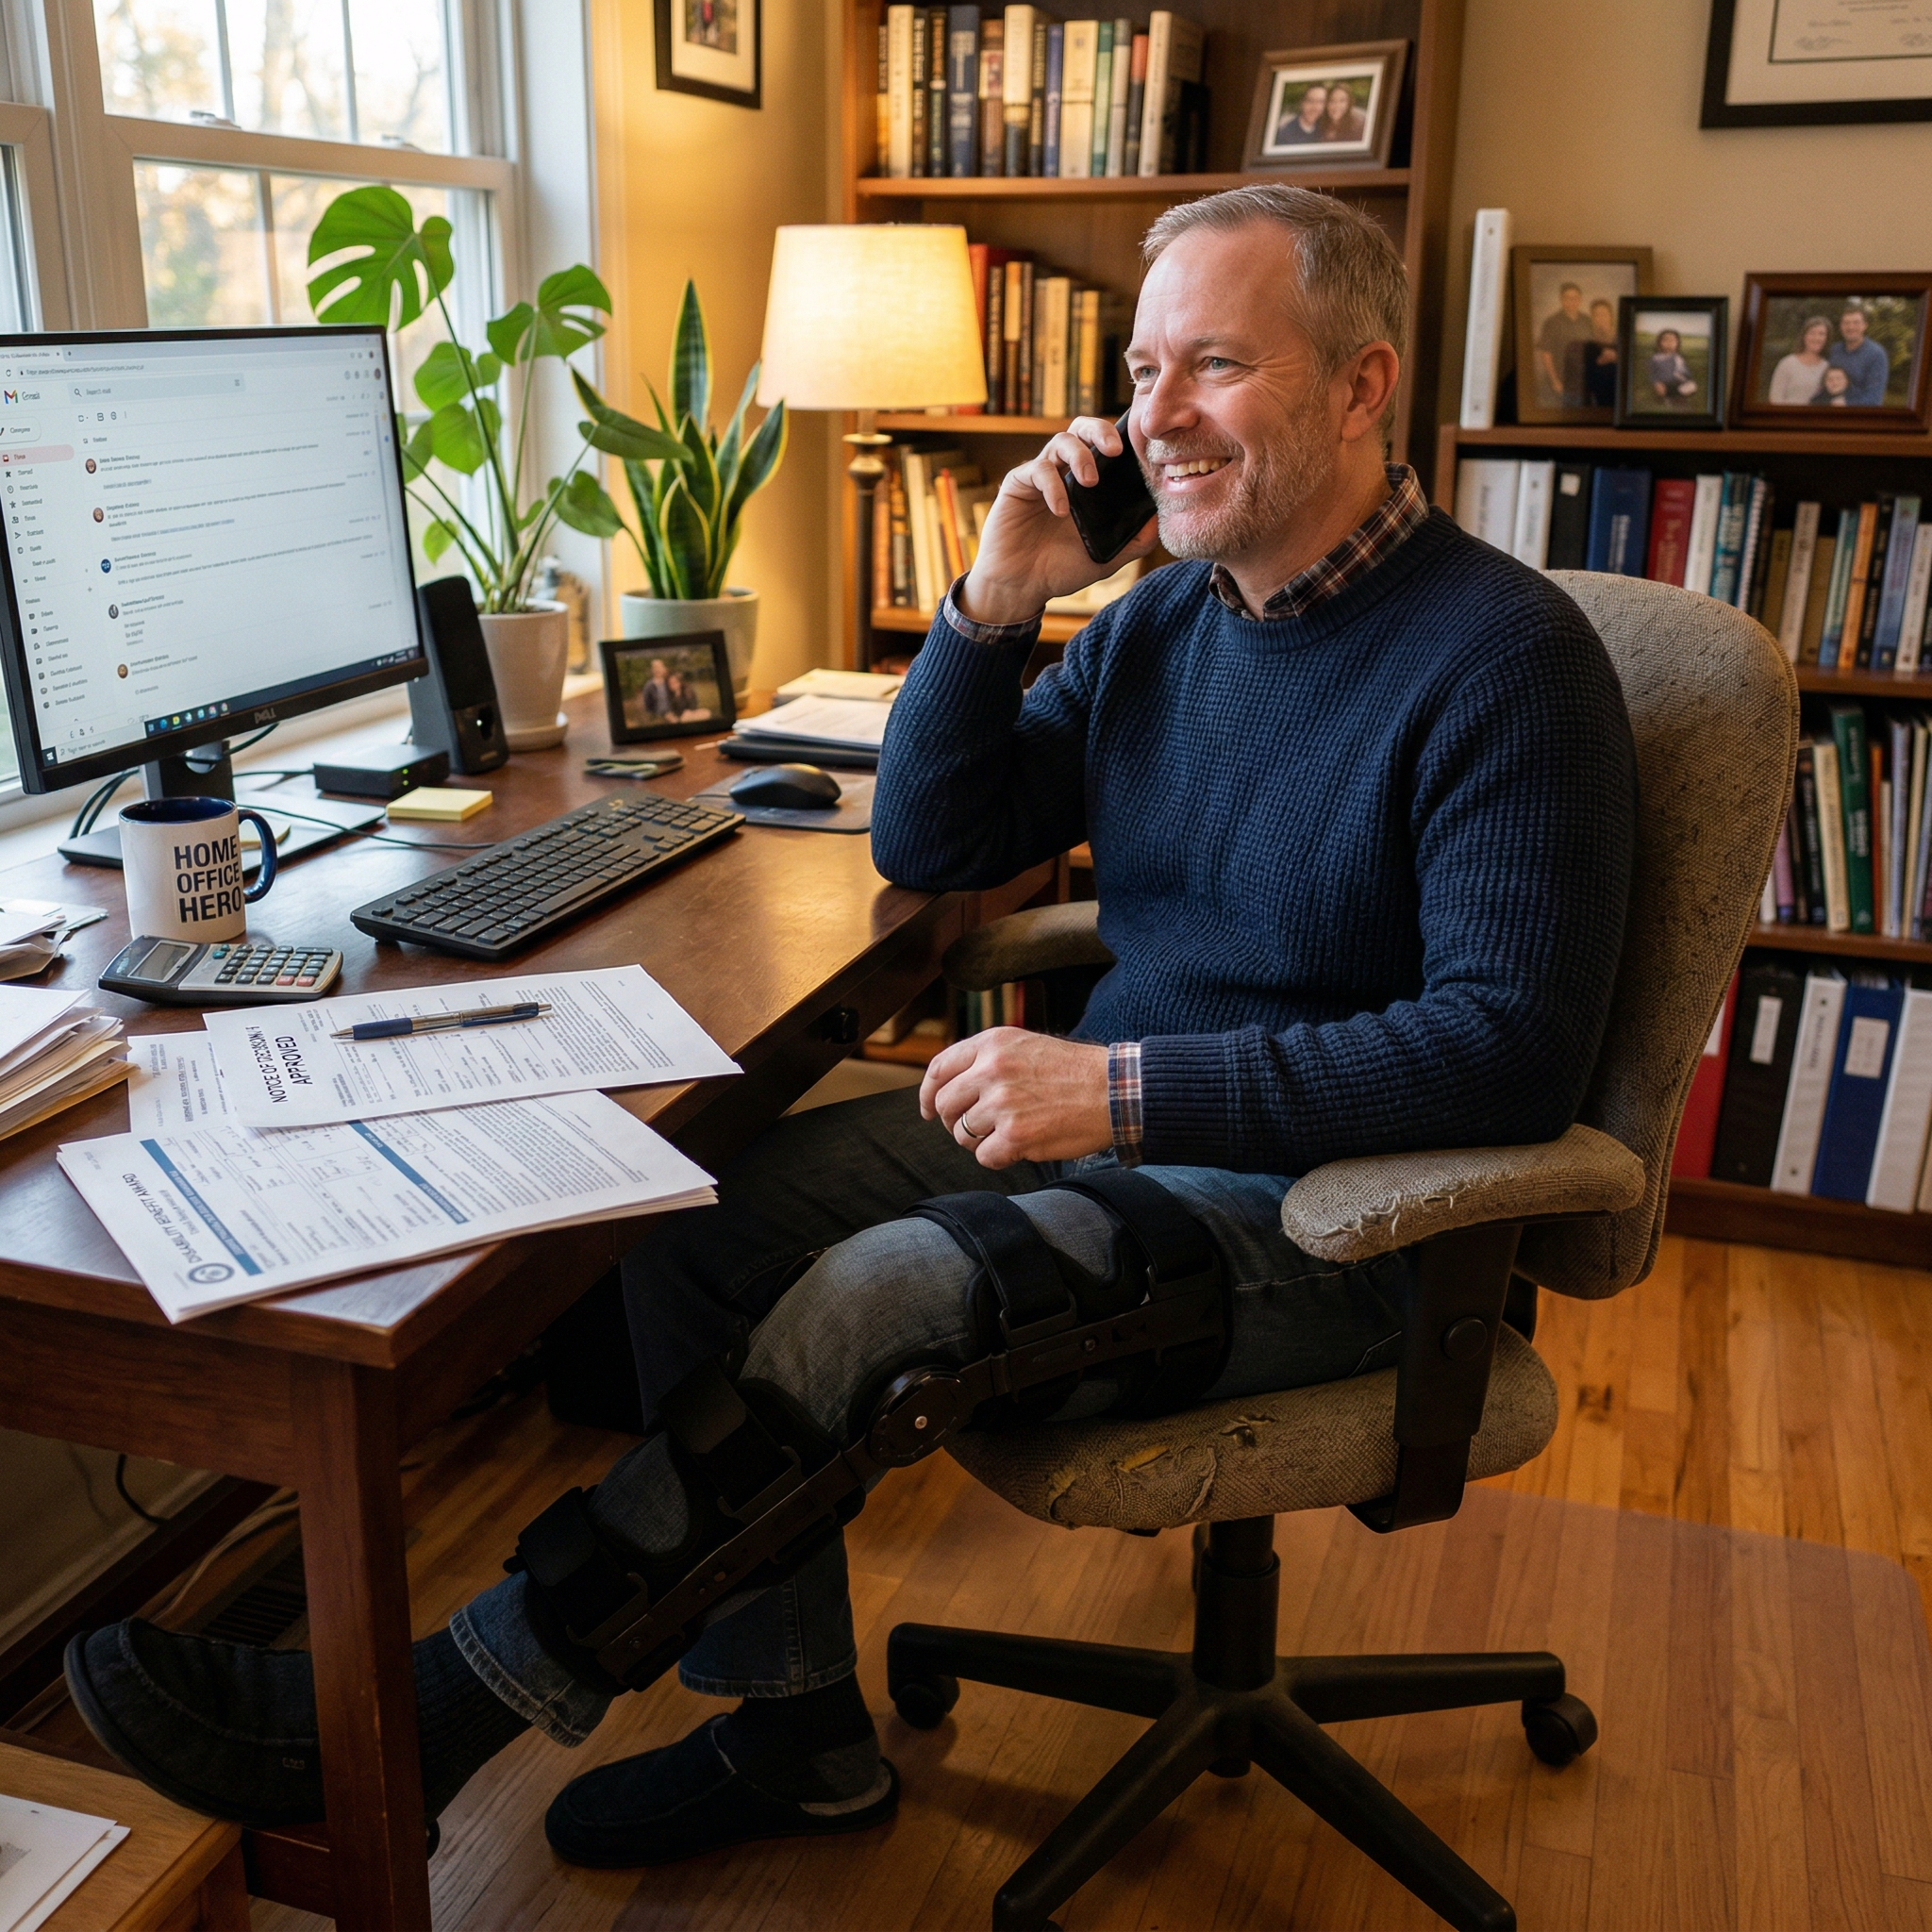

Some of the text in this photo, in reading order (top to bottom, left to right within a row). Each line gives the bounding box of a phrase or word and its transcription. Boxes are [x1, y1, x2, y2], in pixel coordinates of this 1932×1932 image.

[174, 835, 238, 870] HOME
[176, 861, 240, 893] OFFICE
[179, 886, 242, 923] HERO
[258, 1063, 277, 1074] OF
[275, 1035, 313, 1085] APPROVED
[264, 1074, 289, 1104] NOTICE
